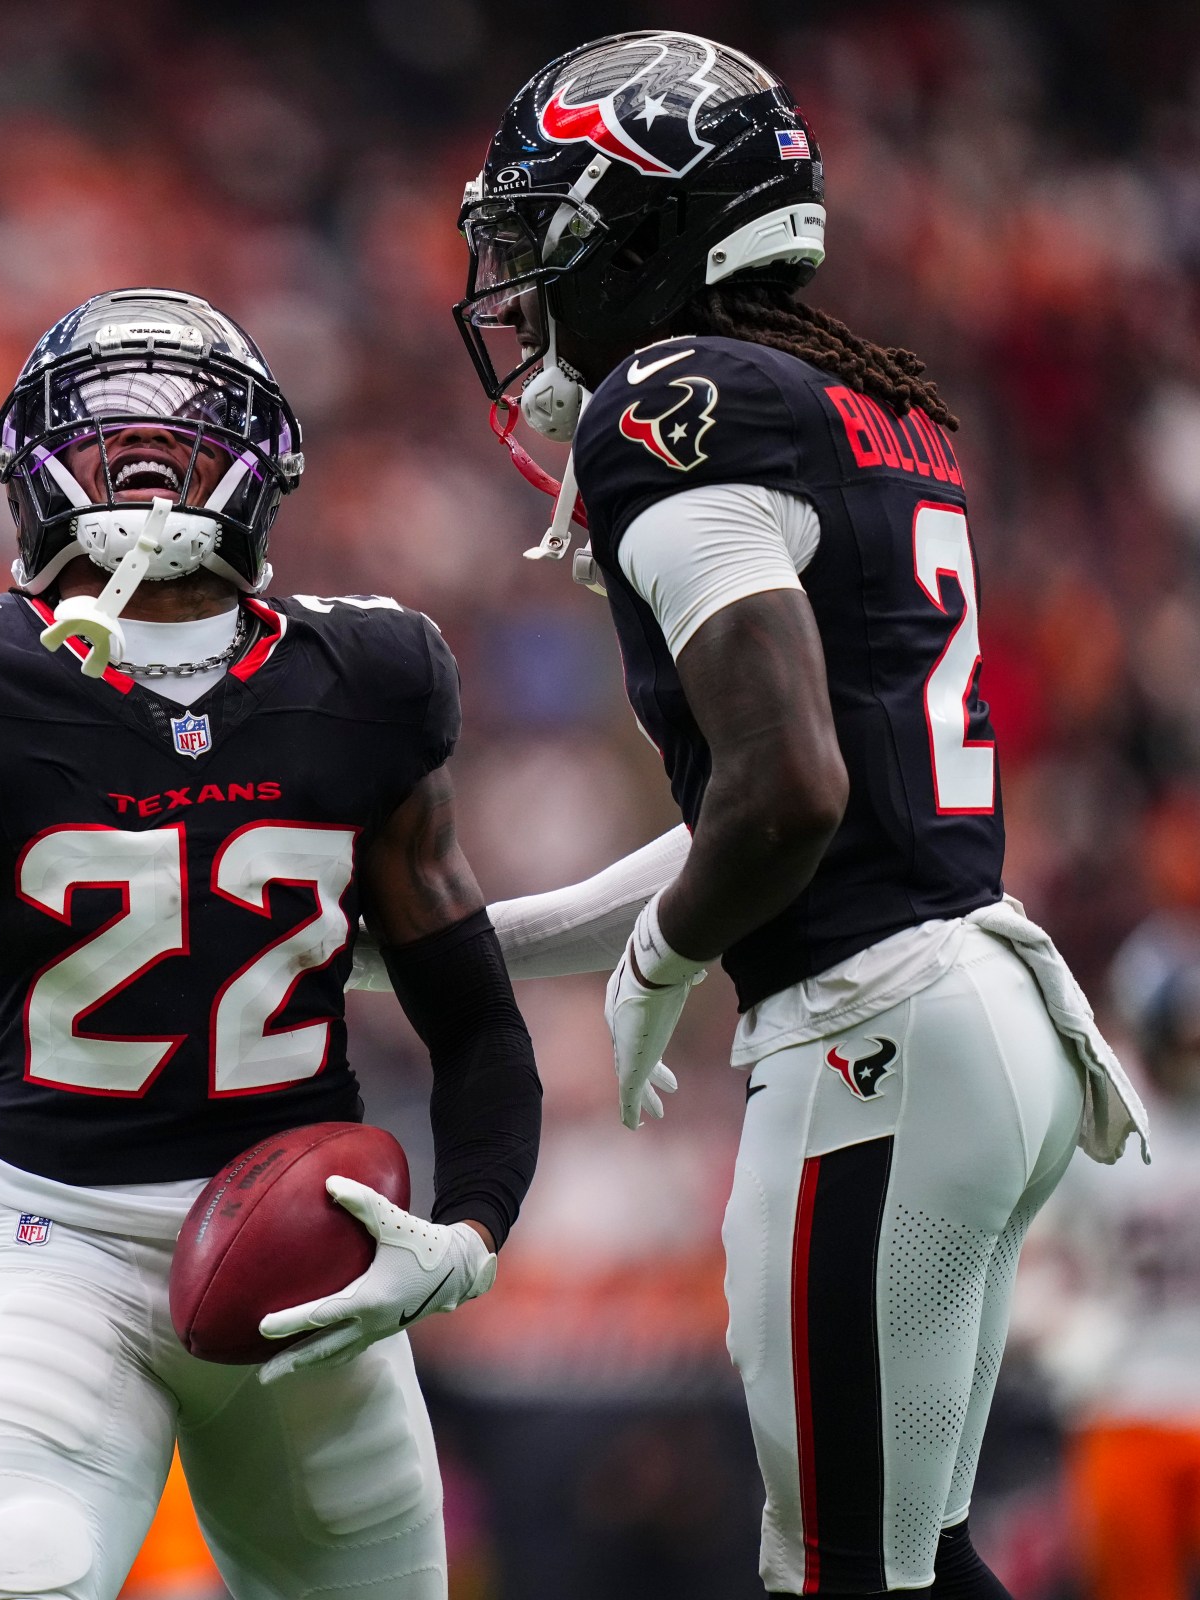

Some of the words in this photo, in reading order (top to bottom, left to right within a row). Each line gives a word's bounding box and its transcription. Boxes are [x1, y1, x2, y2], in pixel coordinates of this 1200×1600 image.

[493, 180, 527, 193] OAKLEY
[824, 385, 965, 490] BULLOC
[912, 500, 995, 815] 2
[179, 732, 205, 751] NFL
[107, 781, 282, 818] TEXANS
[15, 819, 364, 1099] 22
[19, 1225, 44, 1241] NFL
